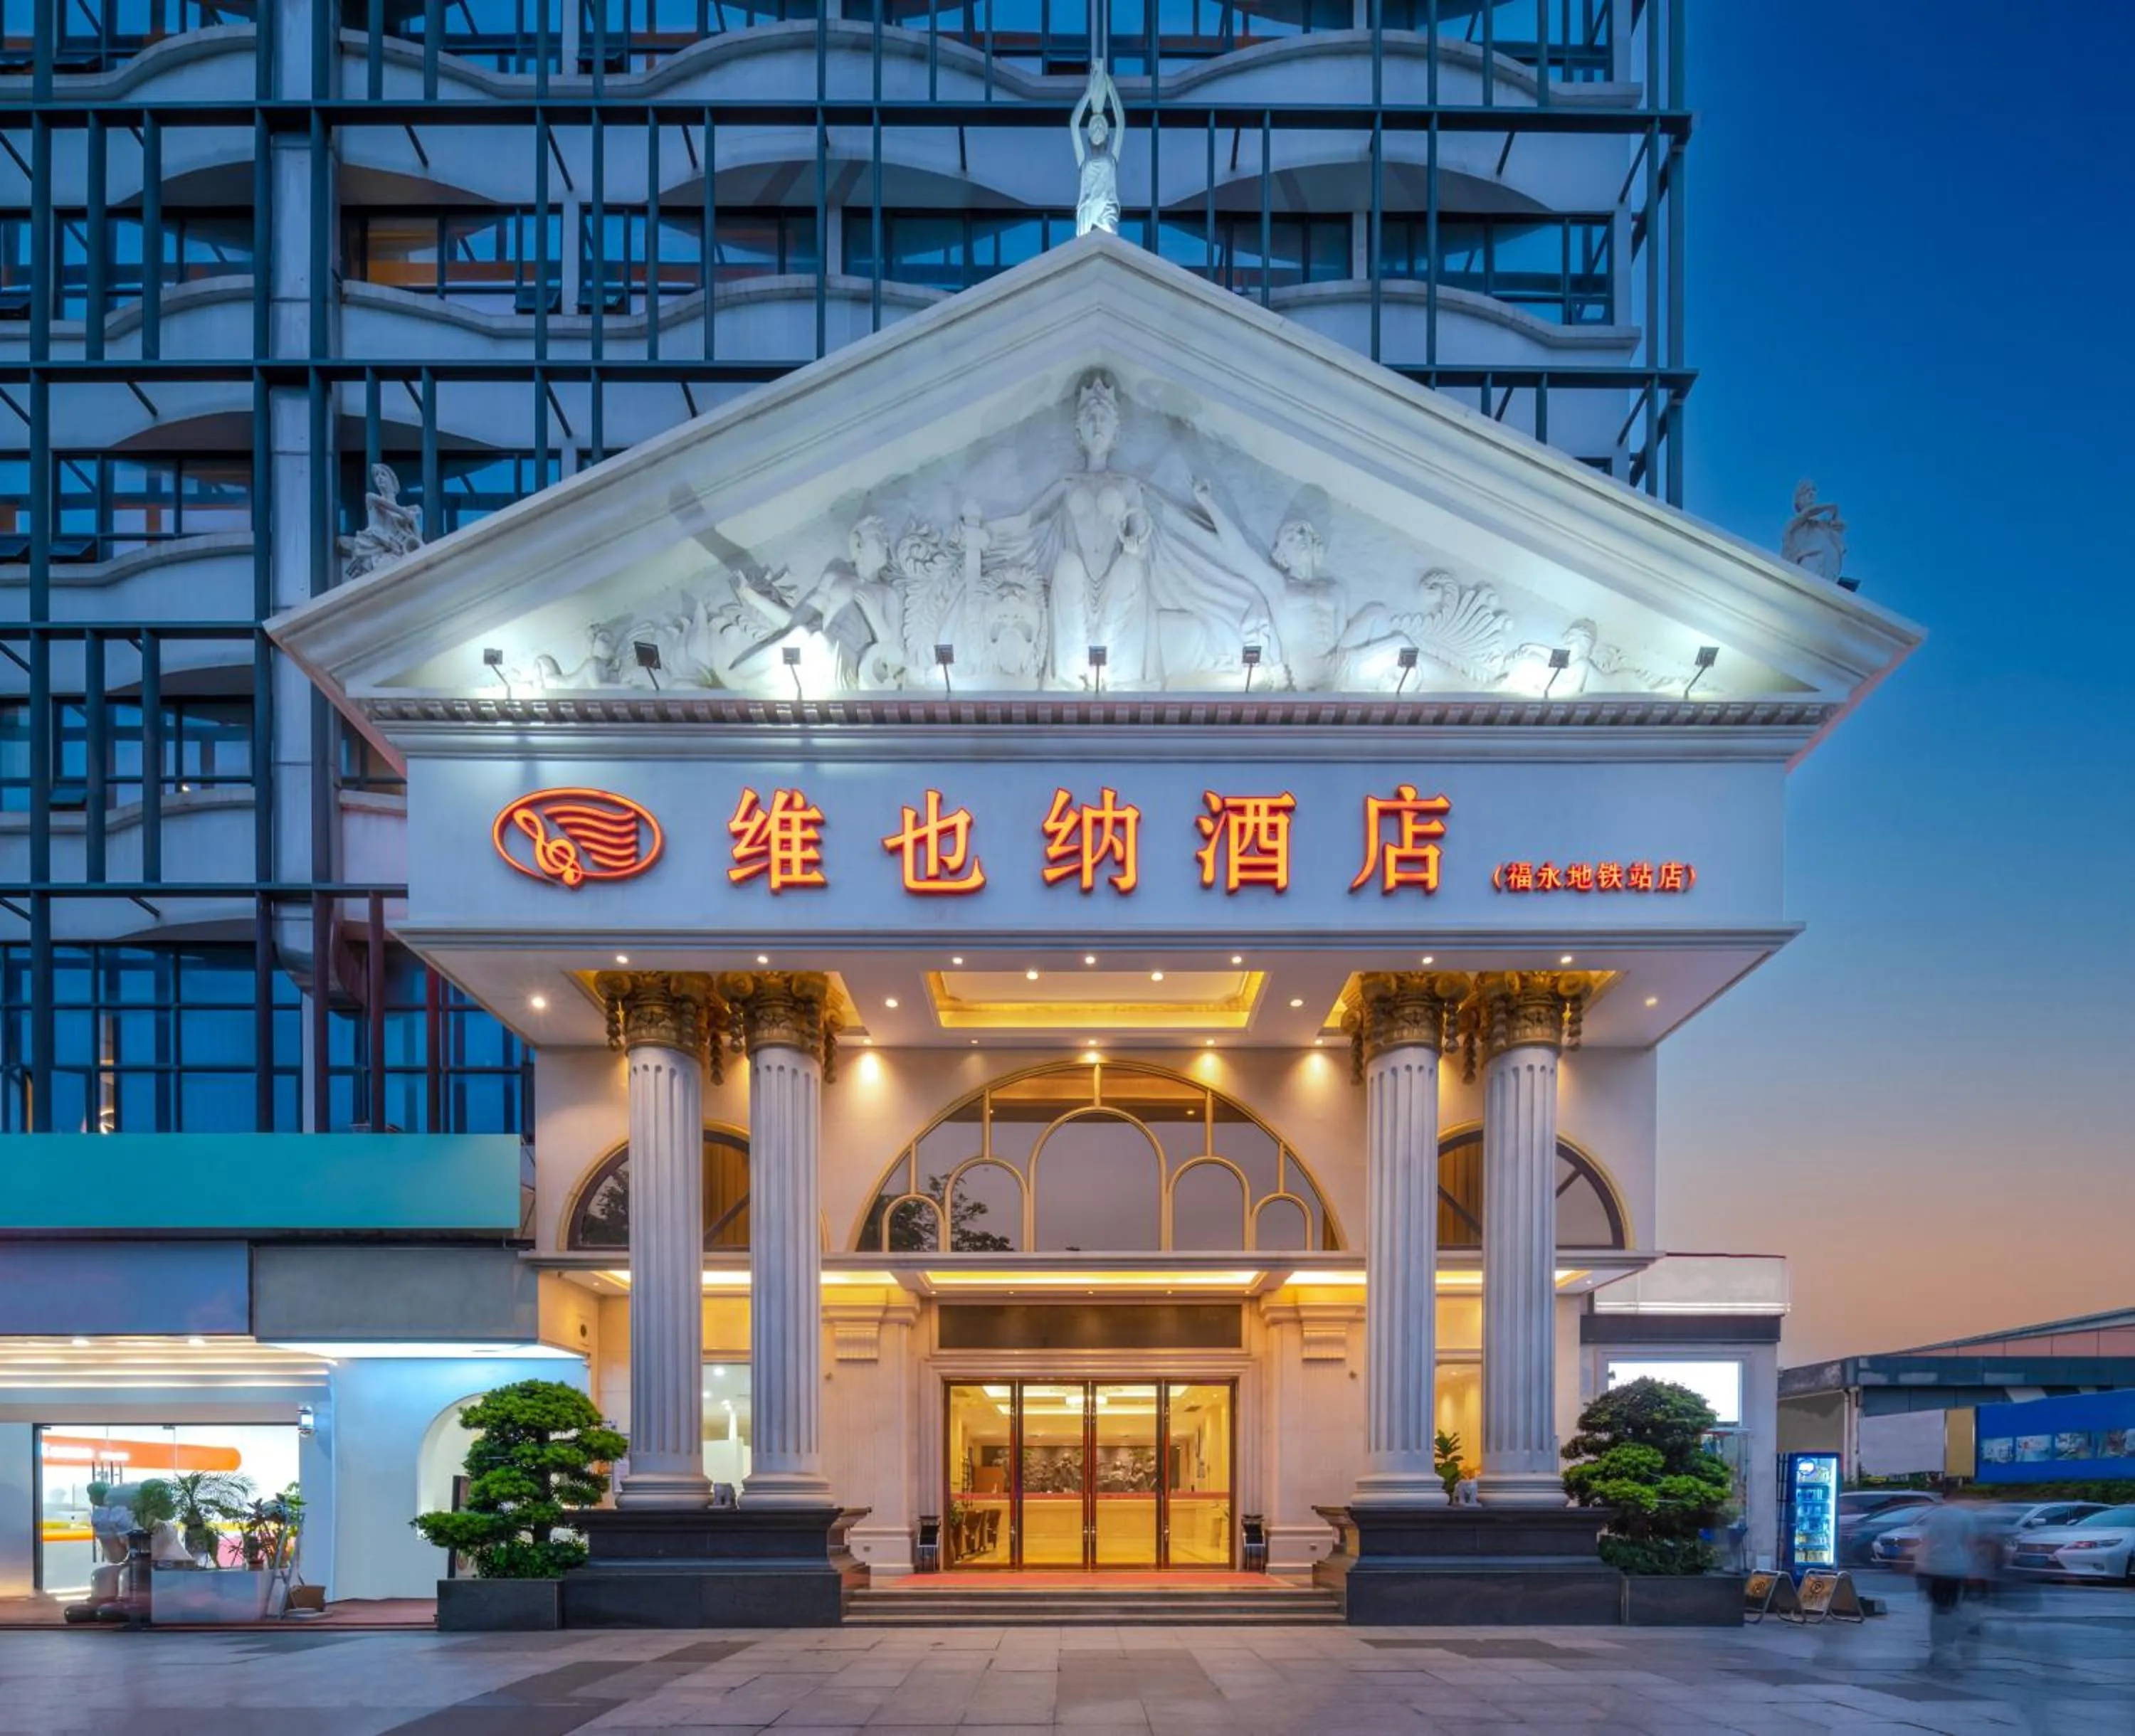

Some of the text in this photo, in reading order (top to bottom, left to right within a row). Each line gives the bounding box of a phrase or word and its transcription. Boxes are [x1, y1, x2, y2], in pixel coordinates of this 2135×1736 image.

[727, 785, 1450, 895] 维也纳酒店
[1492, 861, 1697, 891] (福永地铁站店)
